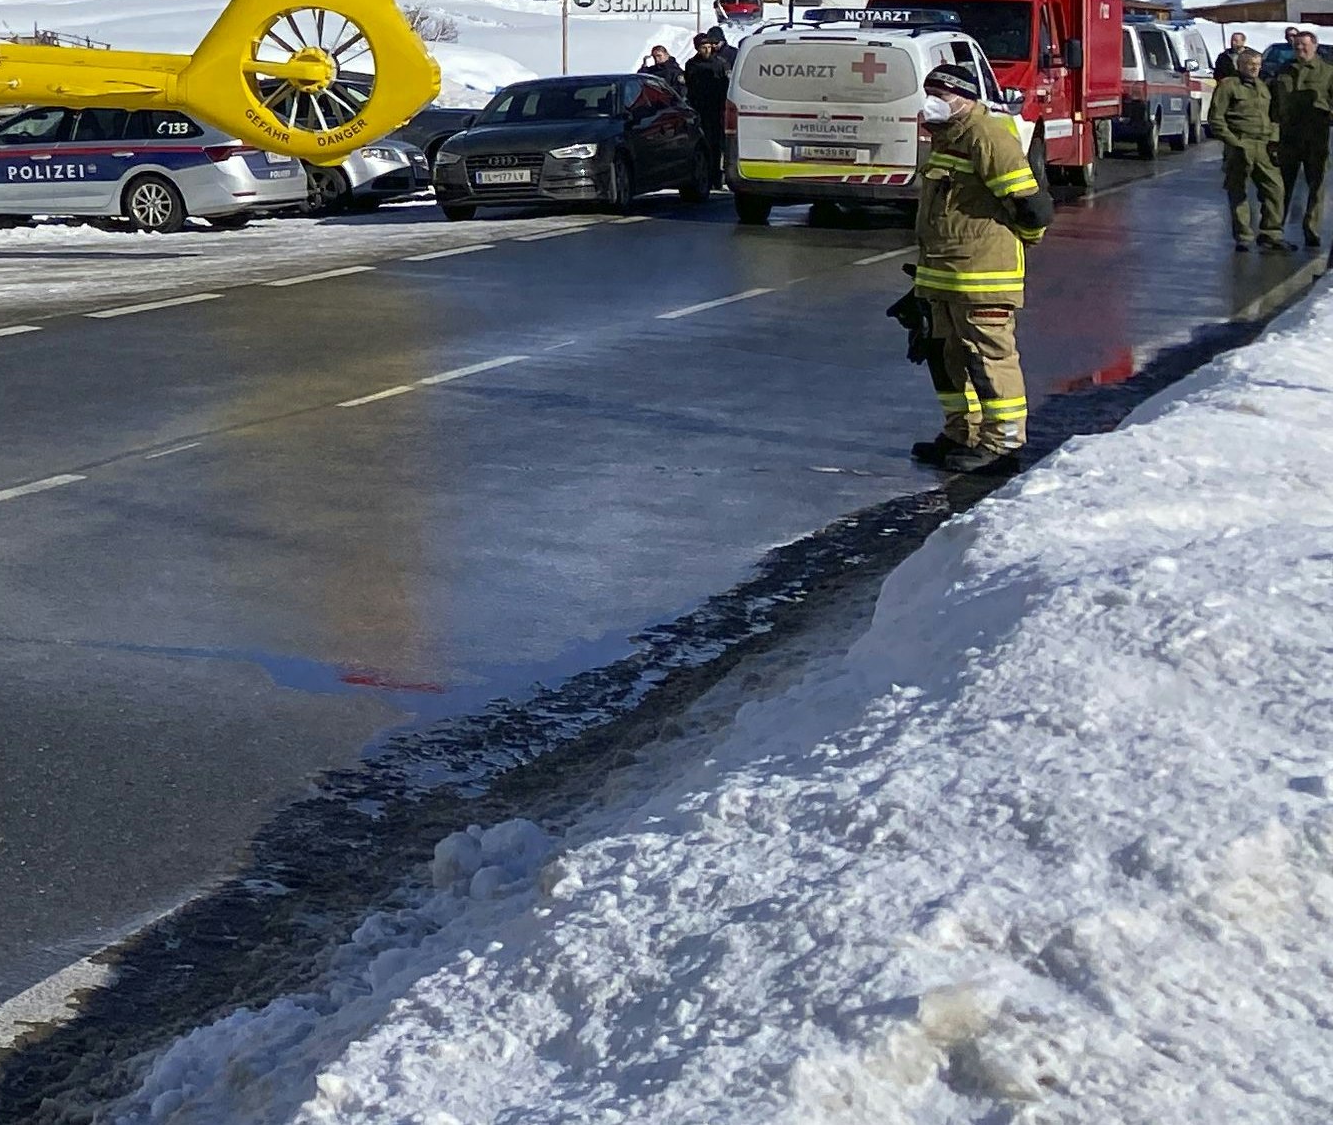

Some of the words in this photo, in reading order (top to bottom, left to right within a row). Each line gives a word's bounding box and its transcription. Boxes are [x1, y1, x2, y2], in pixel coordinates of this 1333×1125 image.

[844, 10, 911, 22] NOTARZT
[759, 63, 837, 79] NOTARZT
[167, 122, 188, 135] 133
[245, 108, 291, 145] GEFAHR
[317, 118, 368, 147] DANGER
[792, 123, 858, 134] AMBULANCE
[7, 164, 85, 181] POLIZEI
